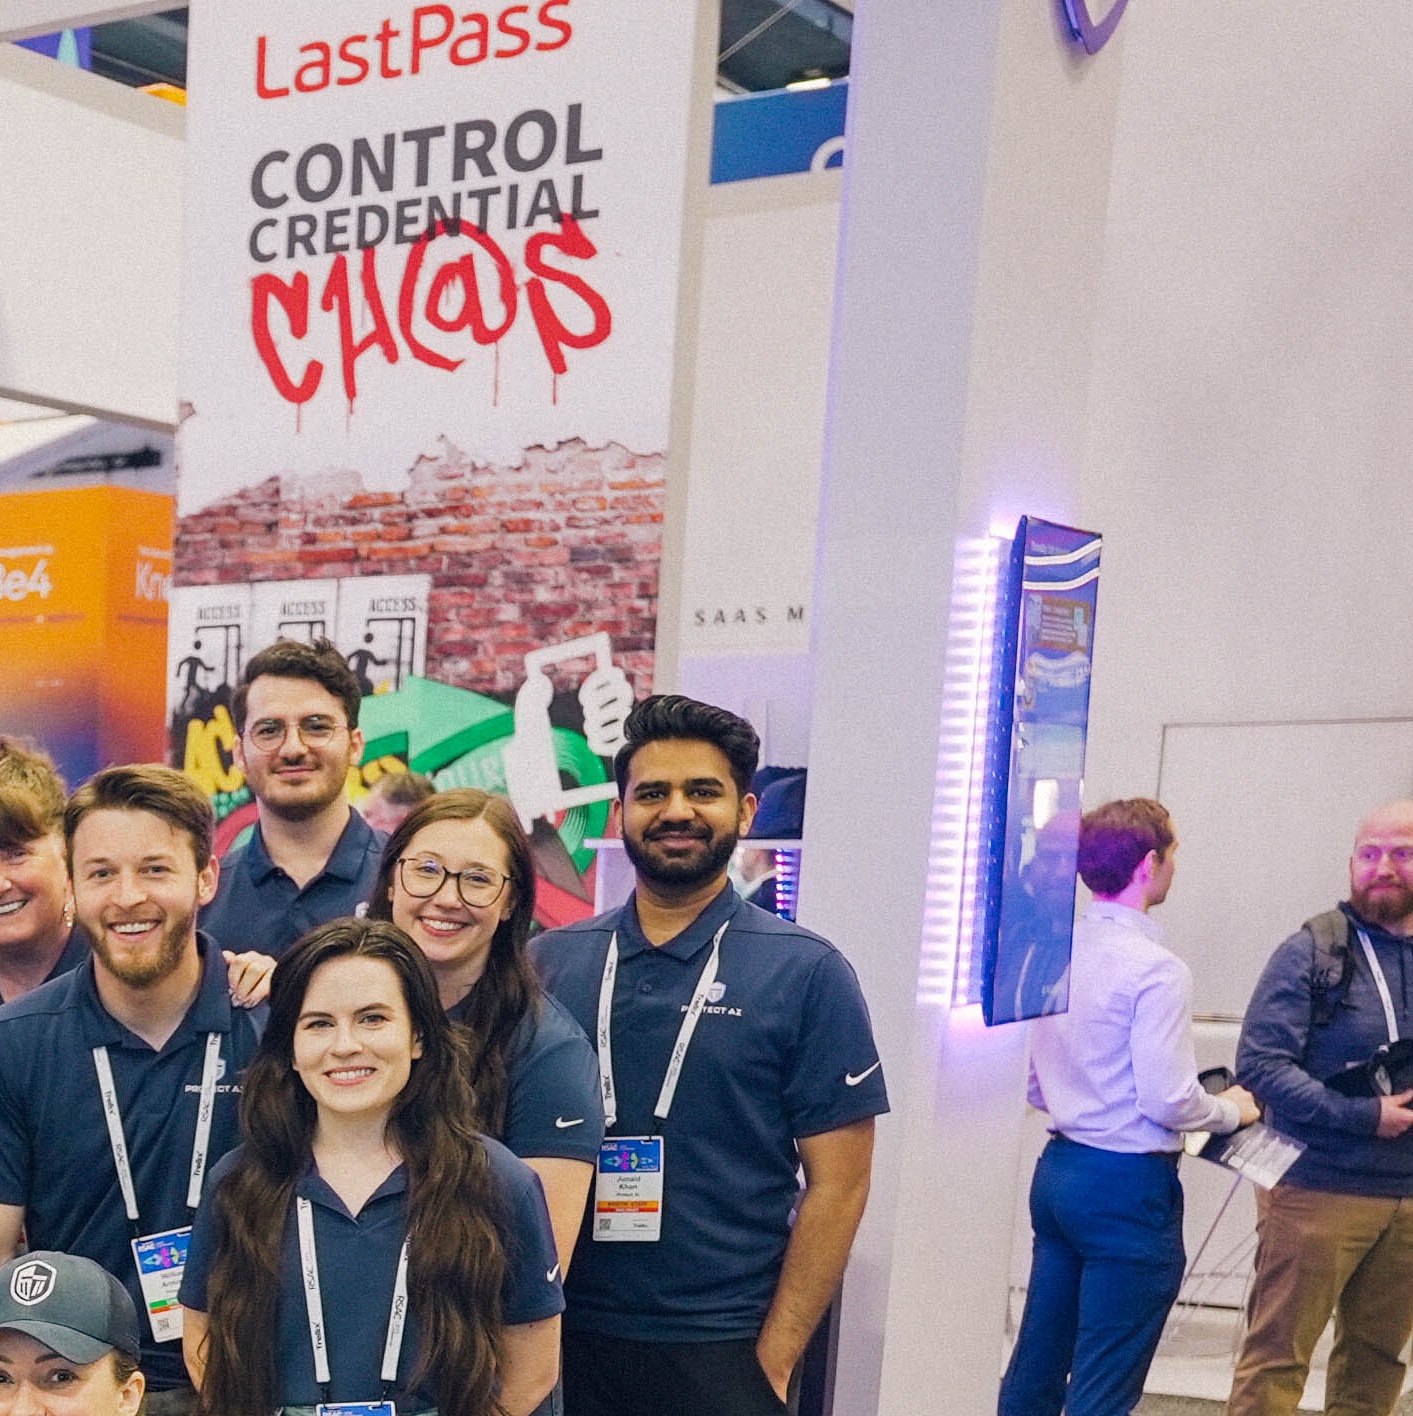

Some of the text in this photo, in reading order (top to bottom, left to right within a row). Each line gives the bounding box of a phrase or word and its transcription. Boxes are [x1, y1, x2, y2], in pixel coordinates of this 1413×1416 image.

[254, 0, 574, 99] LastPass
[250, 103, 603, 209] CONTROL
[249, 174, 600, 263] CREDENTIAL
[694, 606, 767, 626] SAAS
[681, 1004, 727, 1015] PTECT
